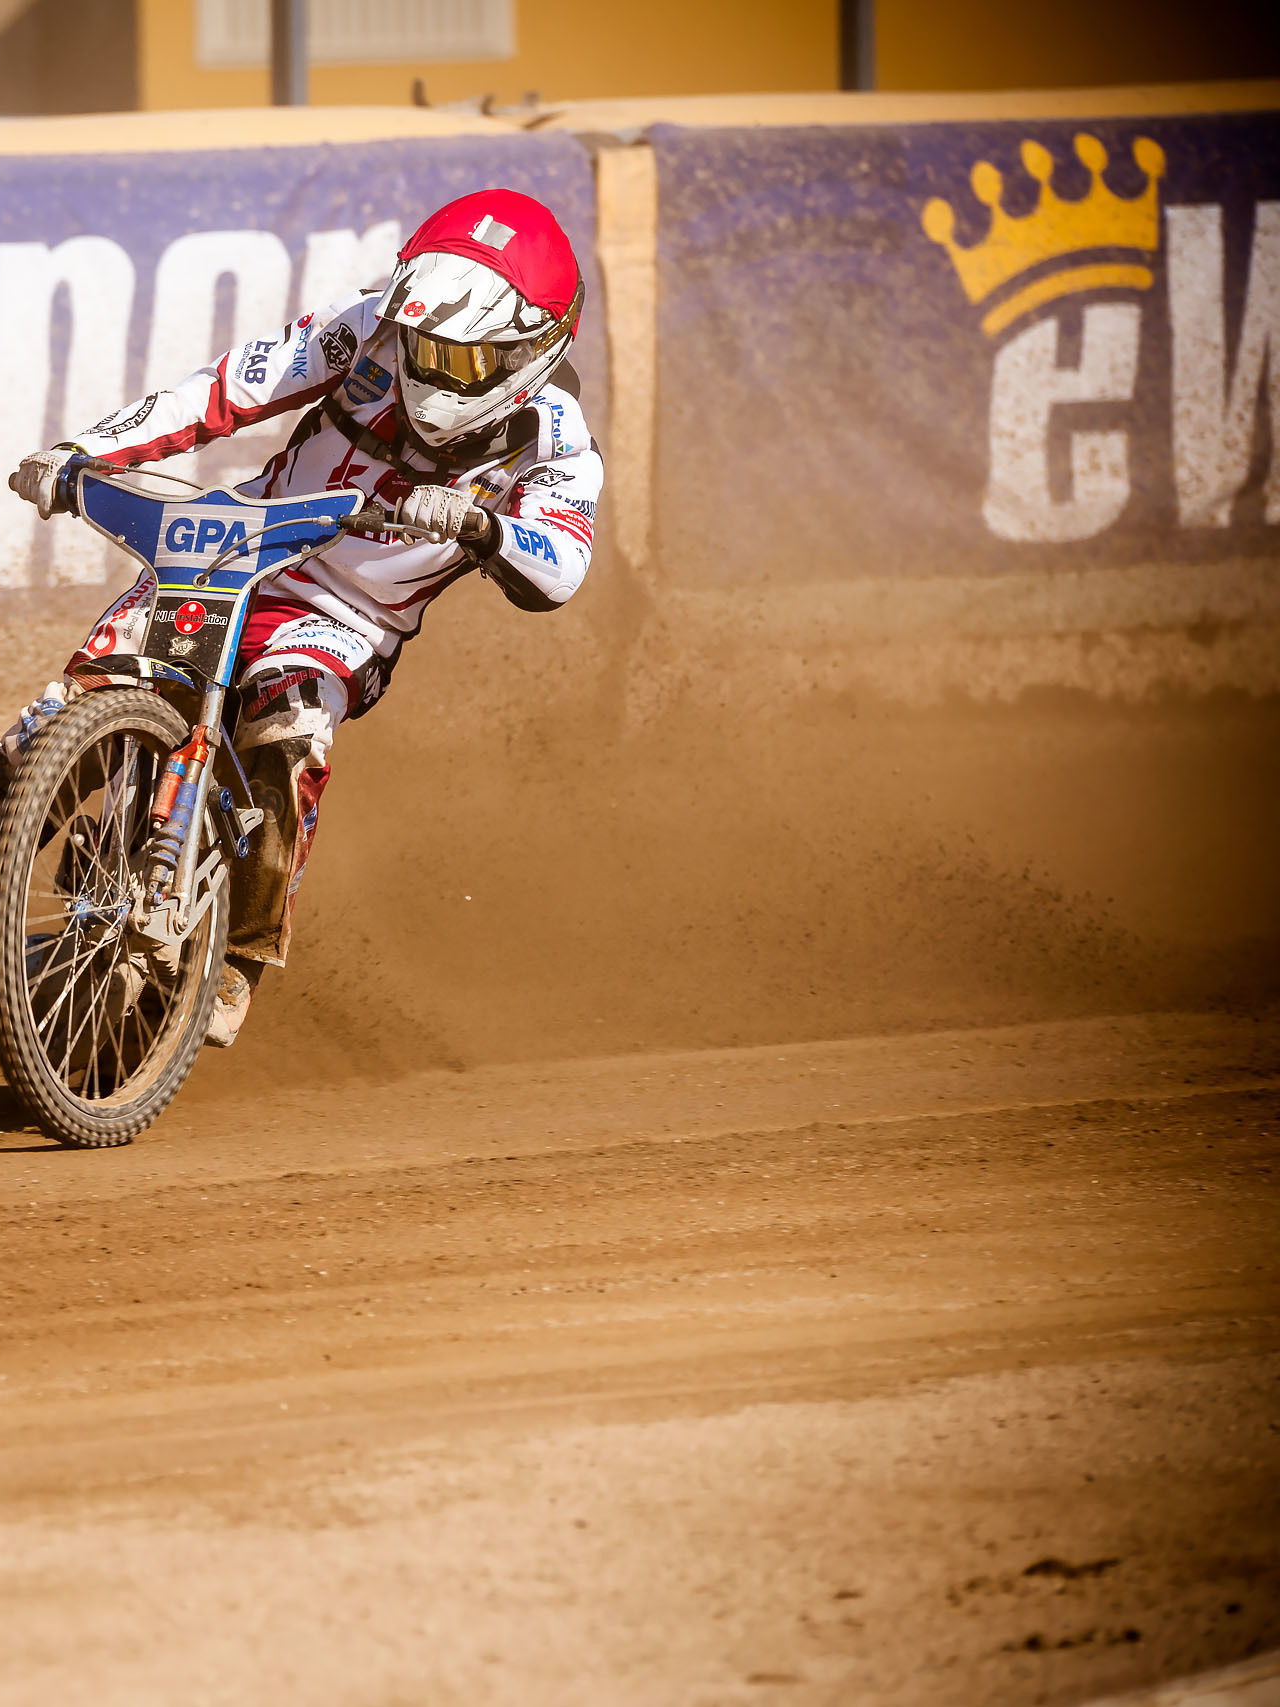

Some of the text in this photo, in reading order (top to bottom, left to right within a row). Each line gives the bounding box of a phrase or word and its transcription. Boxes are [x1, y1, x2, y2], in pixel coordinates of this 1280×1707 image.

[165, 517, 250, 558] GPA
[511, 523, 558, 565] GPA
[122, 614, 138, 640] Global
[154, 610, 168, 622] NJ
[268, 670, 308, 701] Montage
